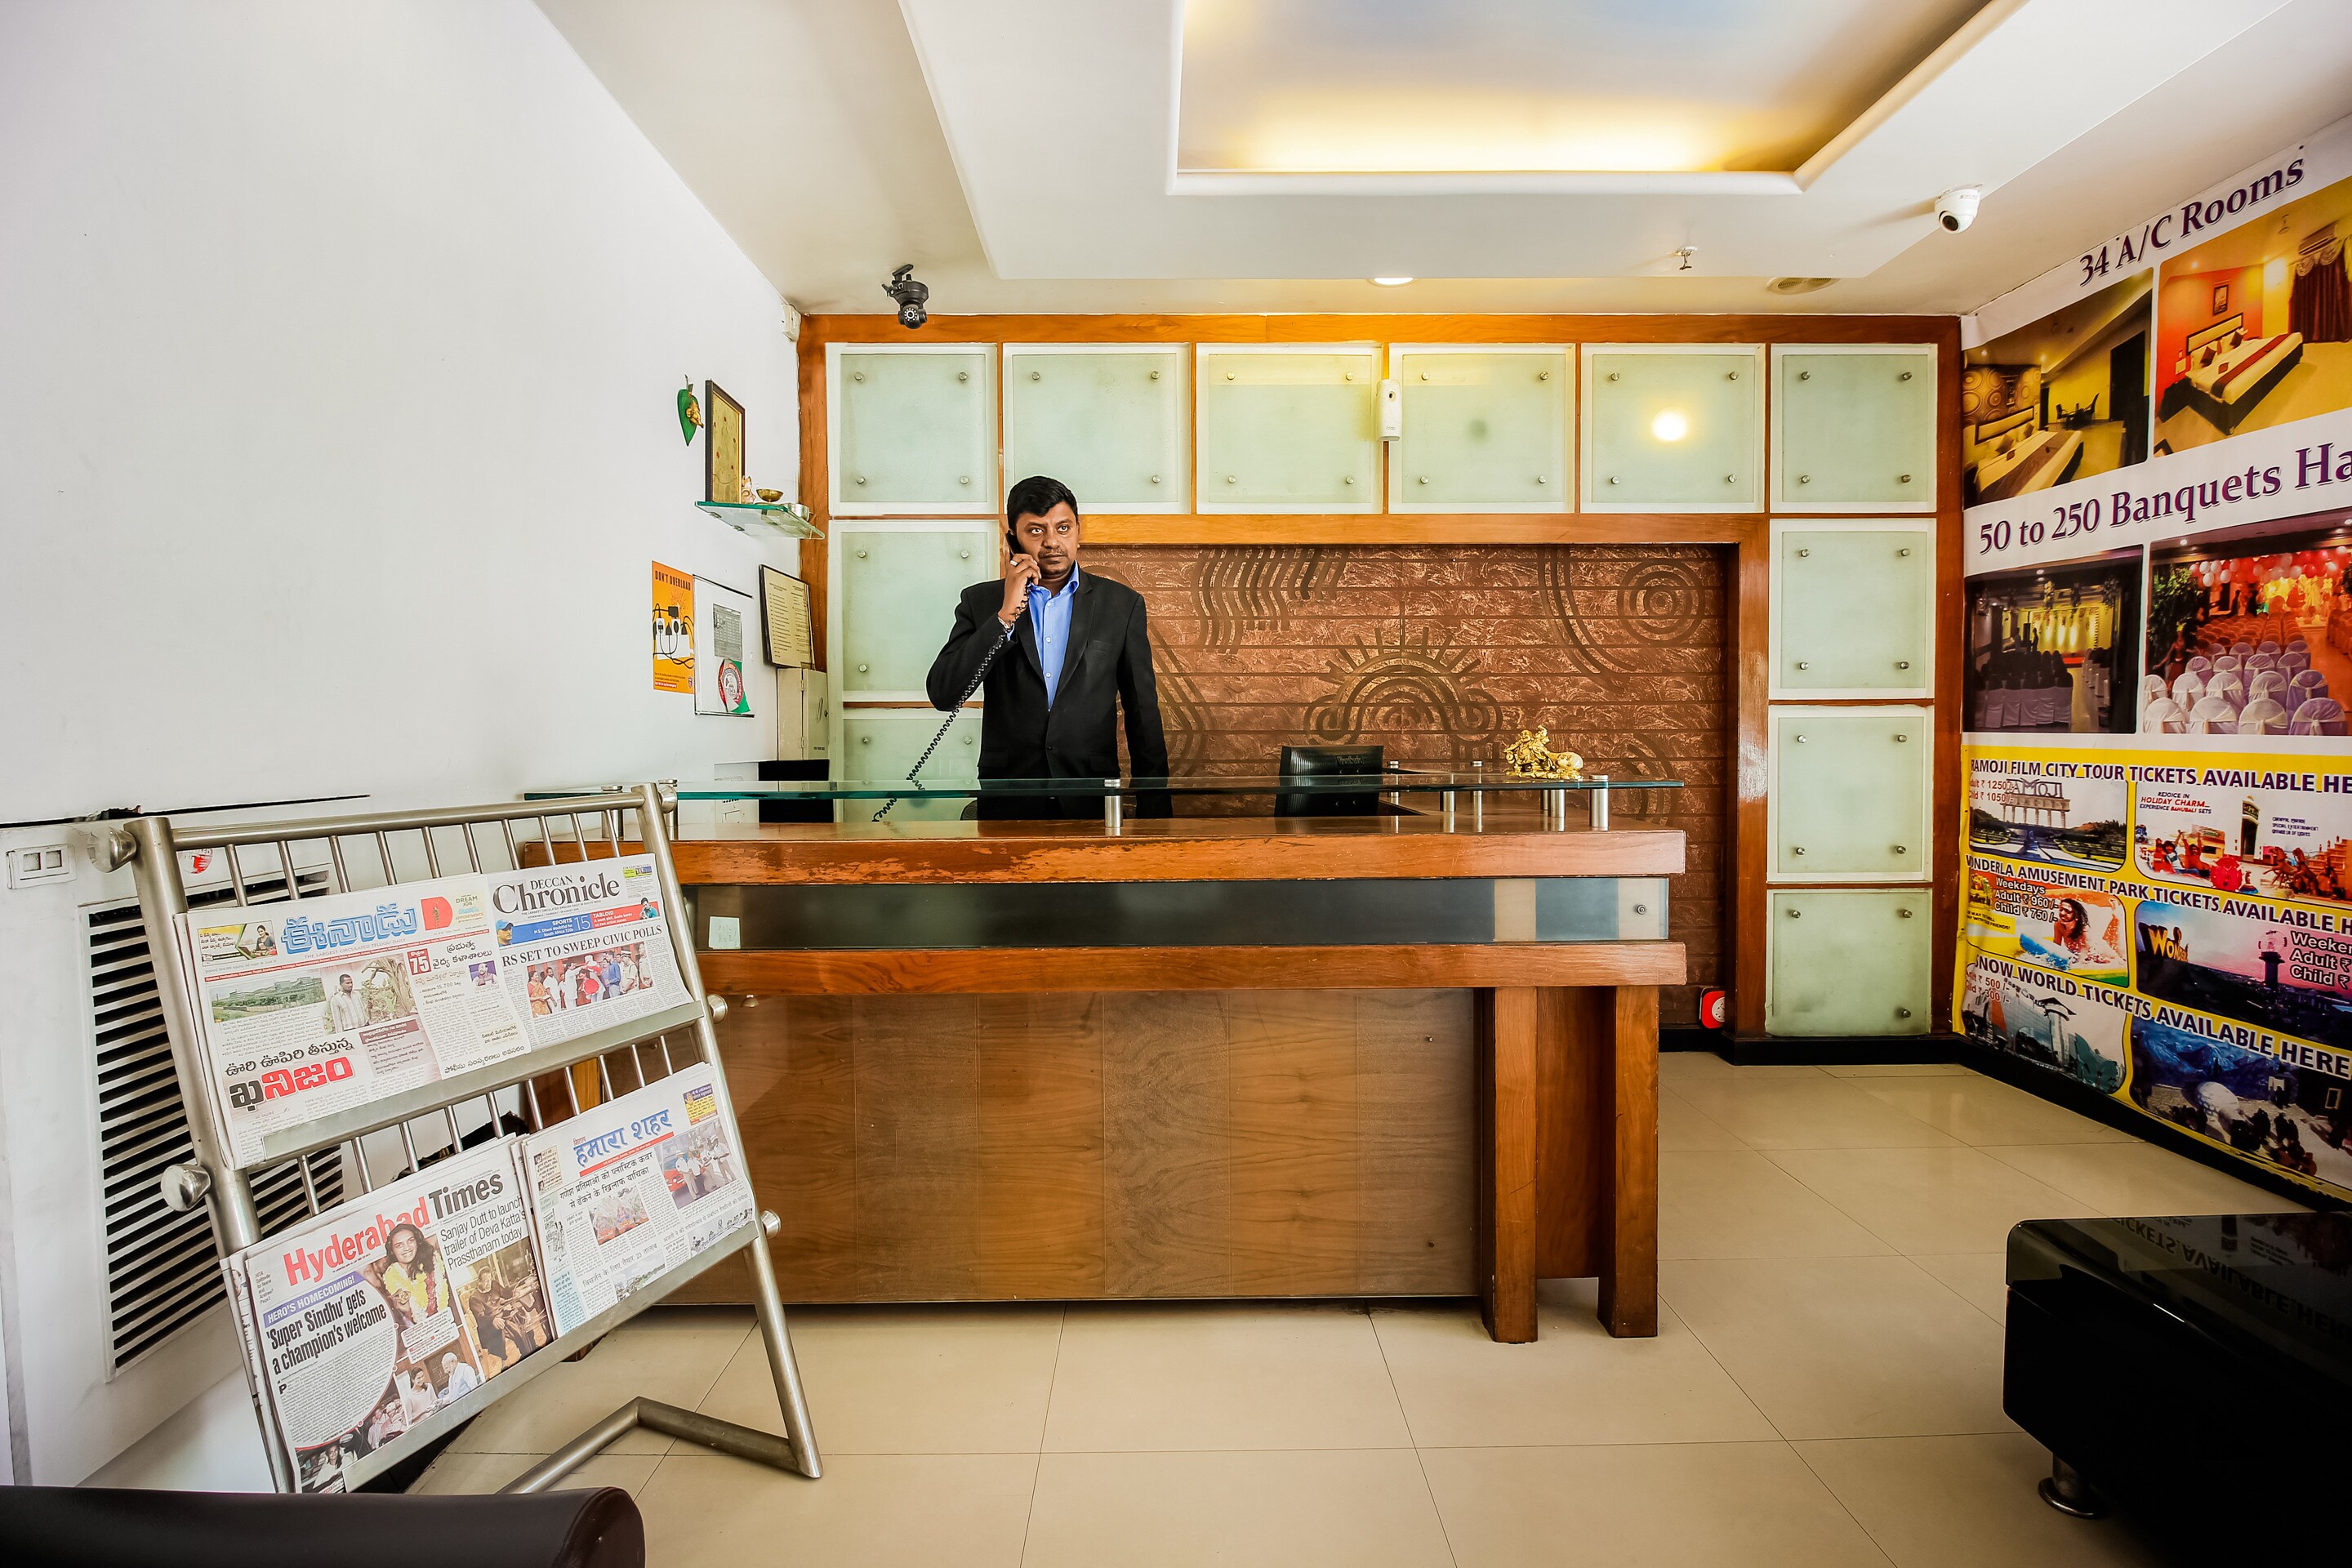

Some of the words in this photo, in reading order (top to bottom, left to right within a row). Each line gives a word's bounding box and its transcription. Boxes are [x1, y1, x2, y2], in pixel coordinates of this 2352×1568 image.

[2079, 252, 2109, 287] 34
[2115, 215, 2172, 268] A/C
[2180, 157, 2305, 238] Rooms
[1980, 519, 2011, 555] 50
[2020, 516, 2045, 546] to
[2051, 499, 2100, 541] 250
[2110, 463, 2282, 524] Banquets
[670, 575, 691, 591] OVERLOAD
[1971, 759, 2007, 775] RAMOJI
[2011, 761, 2041, 776] FILM
[2045, 763, 2078, 777] CITY
[2082, 764, 2124, 780] TOUR
[2129, 765, 2197, 785] TICKETS
[2203, 769, 2315, 792] AVAILABLE
[2140, 803, 2169, 811] EXPERIENCE
[2141, 796, 2172, 805] HOLIDAY
[492, 871, 621, 915] Chronicle
[530, 875, 573, 890] DECCAN
[1996, 877, 2045, 895] Weekdays
[456, 895, 478, 904] DREAM
[1994, 890, 2020, 903] Adult
[2031, 896, 2048, 908] 960
[1994, 902, 2020, 915] Child
[2030, 908, 2048, 921] 750
[2017, 866, 2105, 892] AMUSEMENT
[2109, 880, 2149, 899] PARK
[2154, 887, 2220, 912] TICKETS
[2222, 899, 2335, 933] AVAILABLE
[552, 918, 572, 926] SPORTS
[574, 915, 590, 930] 15
[316, 950, 339, 958] LARGEST
[340, 944, 371, 954] CIRCULATED
[372, 940, 391, 948] TELUGU
[519, 948, 543, 963] SET
[544, 943, 561, 958] TO
[563, 937, 600, 955] SWEEP
[603, 931, 632, 947] CIVIC
[633, 924, 662, 941] POLLS
[409, 956, 430, 974] 75
[2289, 948, 2337, 969] Adult
[1985, 977, 2001, 989] 500
[2290, 964, 2335, 987] Child
[1985, 989, 2000, 1000] 300
[2017, 966, 2077, 996] WORLD
[2082, 984, 2152, 1019] TICKETS
[2155, 1006, 2274, 1057] AVAILABLE
[2280, 1040, 2352, 1080] HERE
[573, 1126, 628, 1168] हमारा
[631, 1109, 673, 1141] शहर
[601, 1171, 610, 1180] को
[638, 1152, 654, 1163] कवर
[429, 1174, 504, 1220] Times
[593, 1188, 601, 1197] के
[440, 1222, 468, 1242] Sanjay
[470, 1211, 488, 1228] Dutt
[488, 1209, 497, 1220] to
[497, 1196, 523, 1216] launch
[443, 1237, 467, 1256] trailer
[469, 1230, 477, 1245] of
[479, 1223, 500, 1240] Deva
[500, 1209, 527, 1230] Katta's
[448, 1237, 501, 1271] Prassthanam
[501, 1227, 523, 1245] today
[268, 1303, 296, 1324] HERO'S
[298, 1275, 356, 1309] HOMECOMING!
[266, 1320, 305, 1350] 'Super
[305, 1296, 343, 1332] Sindhu'
[346, 1289, 367, 1316] gets
[272, 1357, 282, 1375] a
[281, 1325, 344, 1368] champion's
[344, 1303, 387, 1339] welcome
